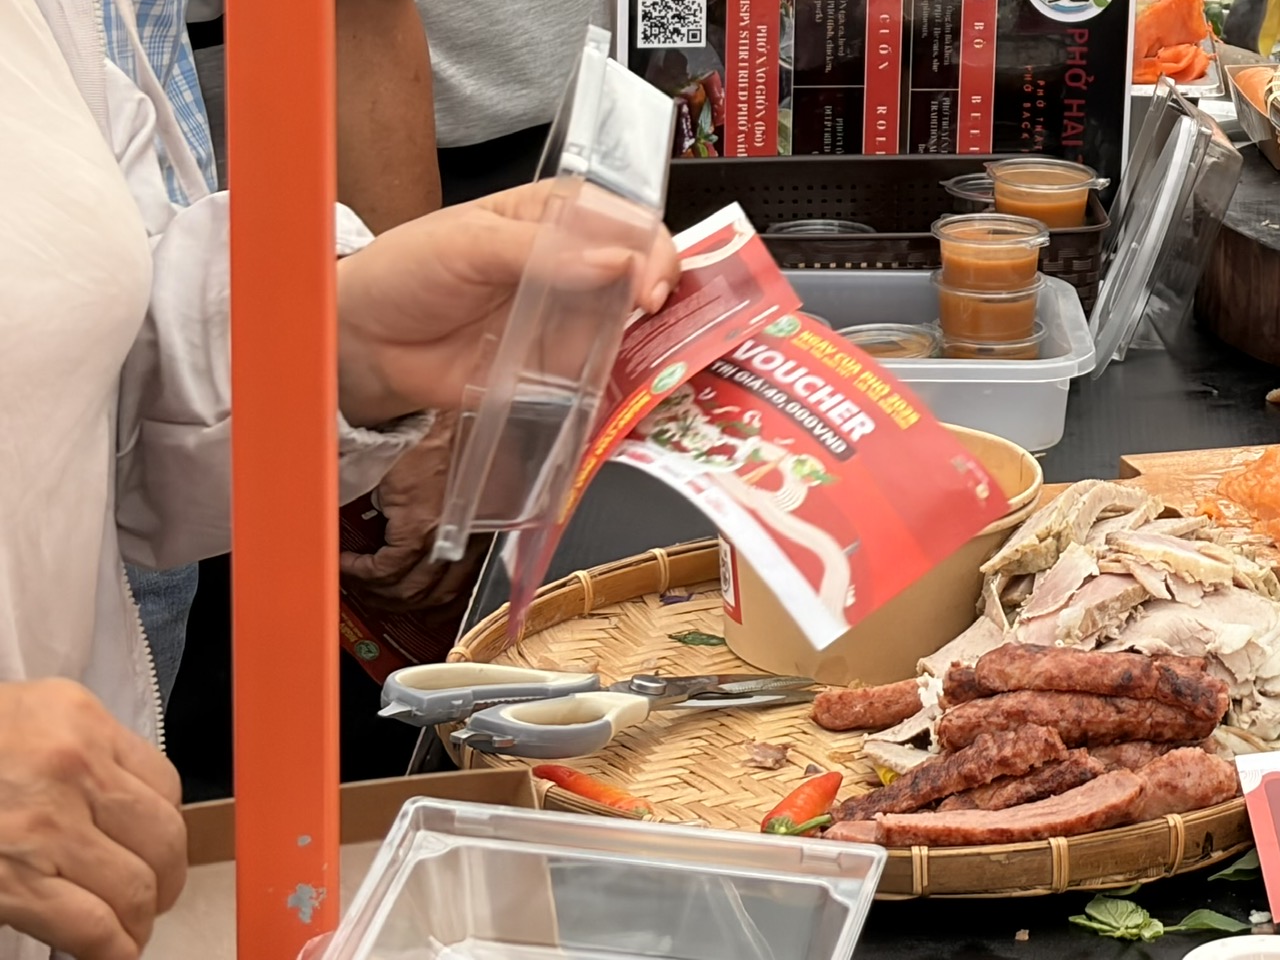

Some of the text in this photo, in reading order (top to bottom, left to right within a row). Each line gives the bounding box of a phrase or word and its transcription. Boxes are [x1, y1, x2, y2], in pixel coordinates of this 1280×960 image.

[973, 22, 987, 49] BÒ
[1061, 28, 1095, 146] PHỞ HAI
[731, 339, 876, 442] VOUCHER
